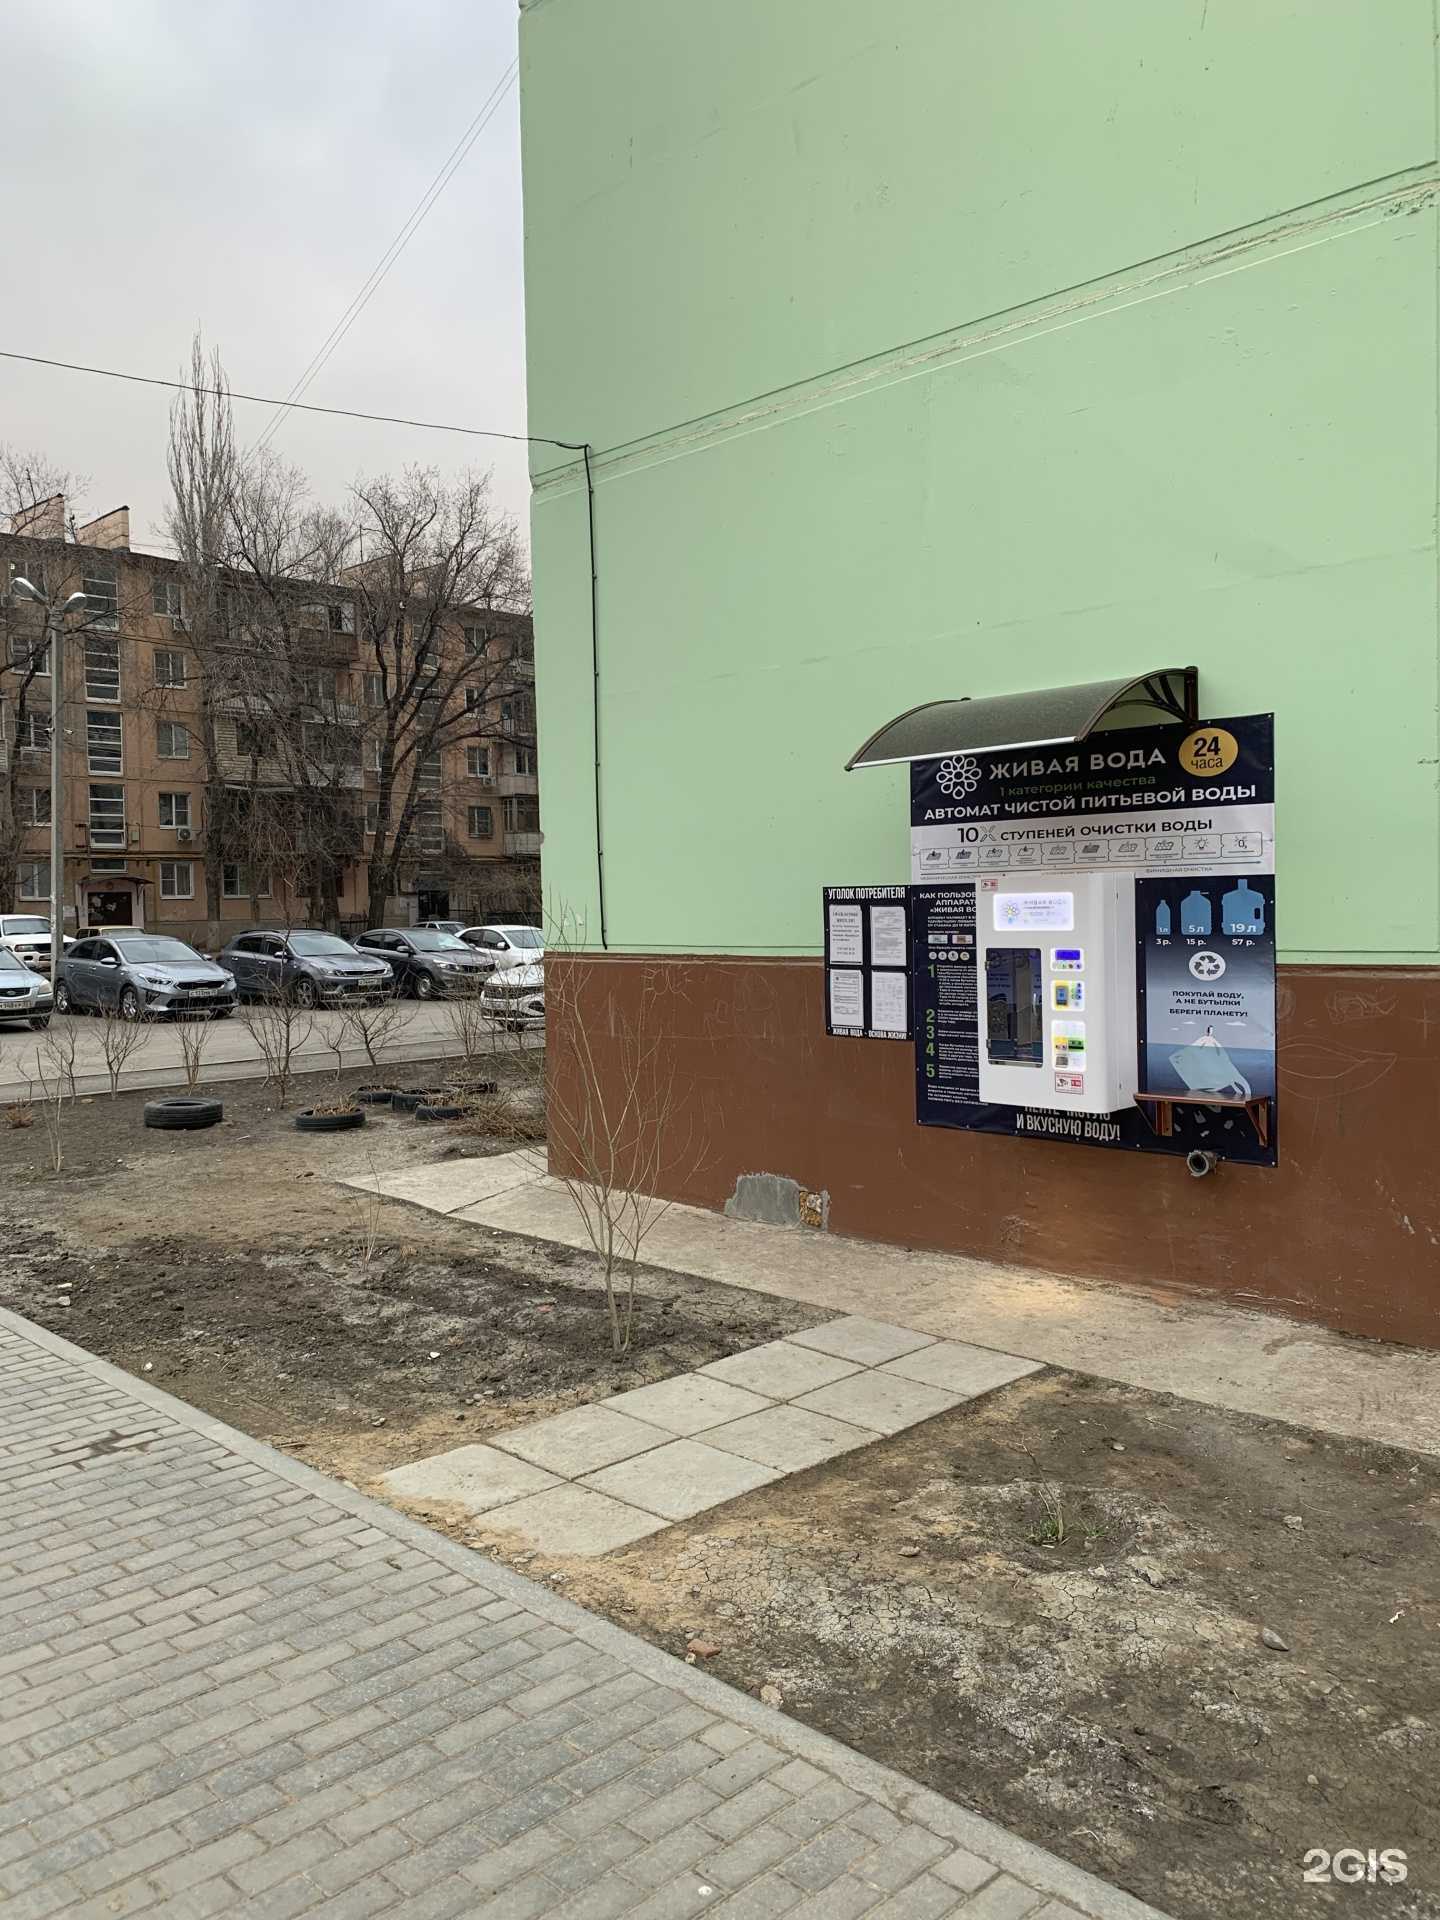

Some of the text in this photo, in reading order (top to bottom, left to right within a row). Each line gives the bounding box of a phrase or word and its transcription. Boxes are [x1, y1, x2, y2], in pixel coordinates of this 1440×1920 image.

[1193, 736, 1221, 758] 24
[989, 748, 1167, 780] ЖИВАЯ ВОДА
[1190, 757, 1224, 770] часа
[1008, 782, 1083, 796] категории
[1087, 776, 1157, 790] качества
[924, 784, 1257, 820] АВТОМАТ ЧИСТОЙ ПИТЬЕВОЙ ВОДЫ
[957, 819, 1213, 843] 10 СТУПЕНЕЙ ОЧИСТКИ ВОДЫ
[828, 886, 906, 900] УГОЛОК ПОТРЕБИТЕЛЯ
[928, 964, 934, 978] 1
[1172, 990, 1244, 1000] ПОКУПАЙ ВОДУ,
[926, 1008, 935, 1023] 2
[1204, 1010, 1248, 1018] ПЛАНЕТУ!
[926, 1026, 935, 1039] 3
[926, 1042, 935, 1056] 4
[926, 1064, 935, 1078] 5
[1016, 1113, 1024, 1129] И
[1026, 1114, 1082, 1136] ВКУСНУЮ
[1084, 1121, 1121, 1141] ВОДУ!
